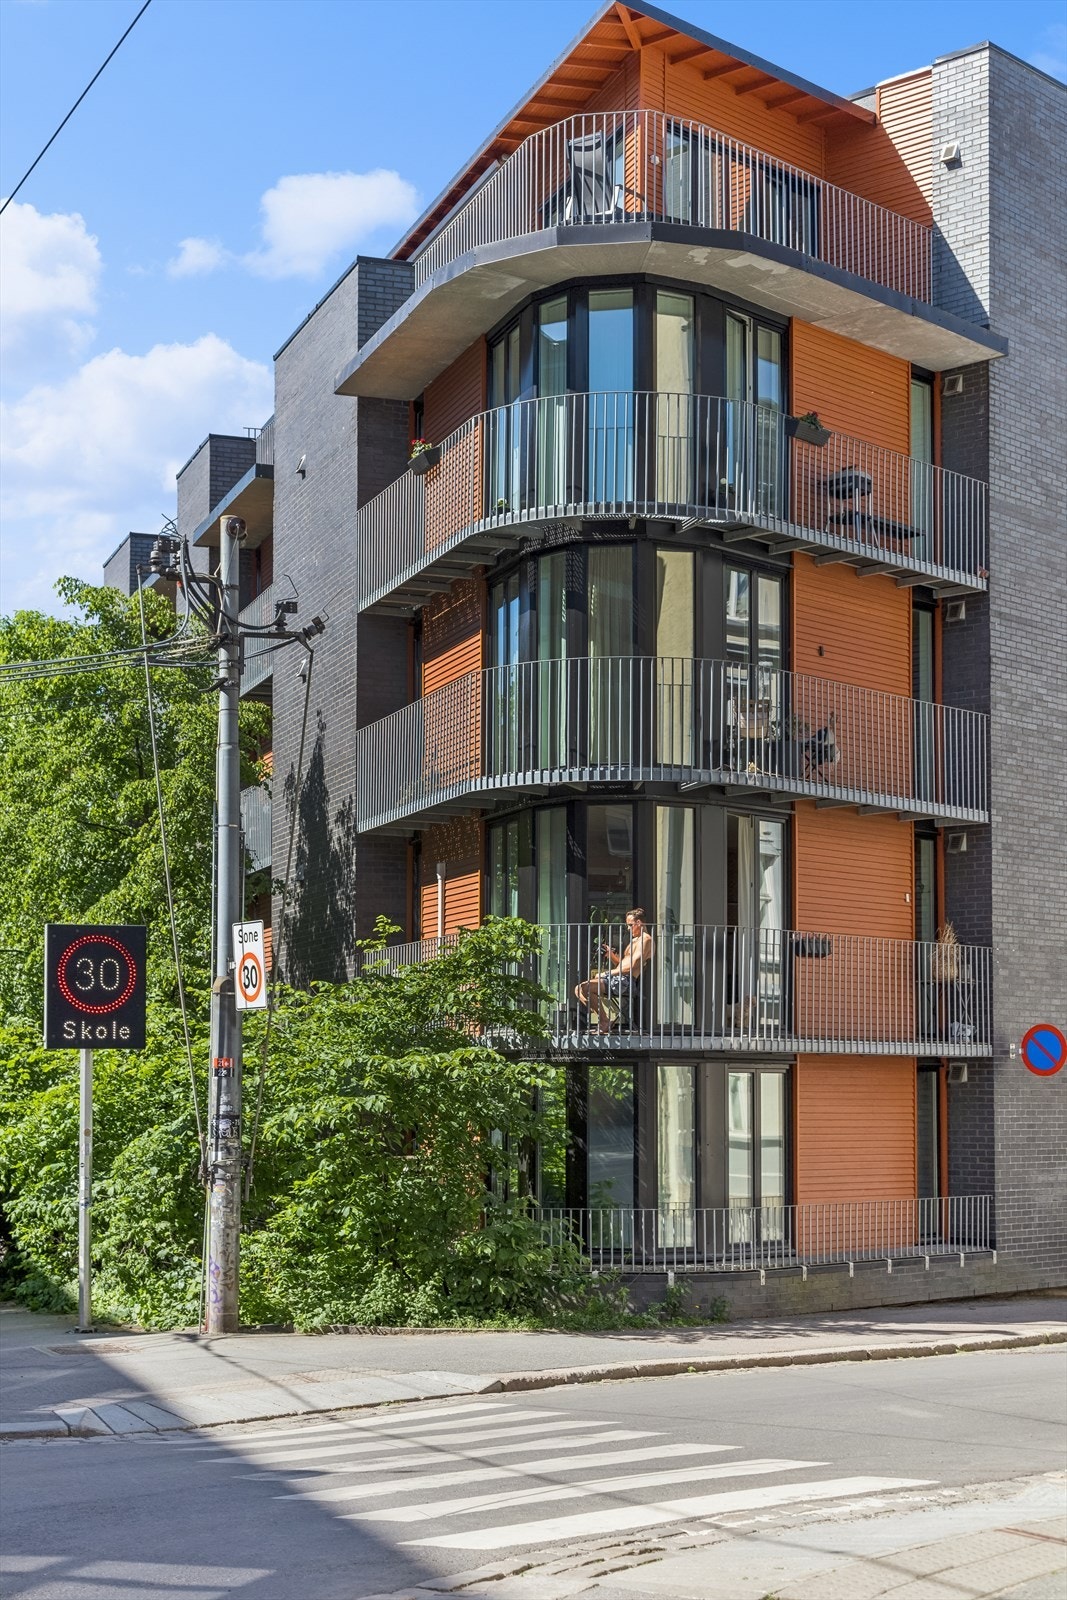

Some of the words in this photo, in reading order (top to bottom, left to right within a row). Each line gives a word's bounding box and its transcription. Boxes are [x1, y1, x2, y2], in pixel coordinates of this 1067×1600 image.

[238, 929, 259, 944] Sone
[75, 958, 120, 991] 30
[243, 965, 258, 989] 30
[63, 1020, 130, 1039] Skole
